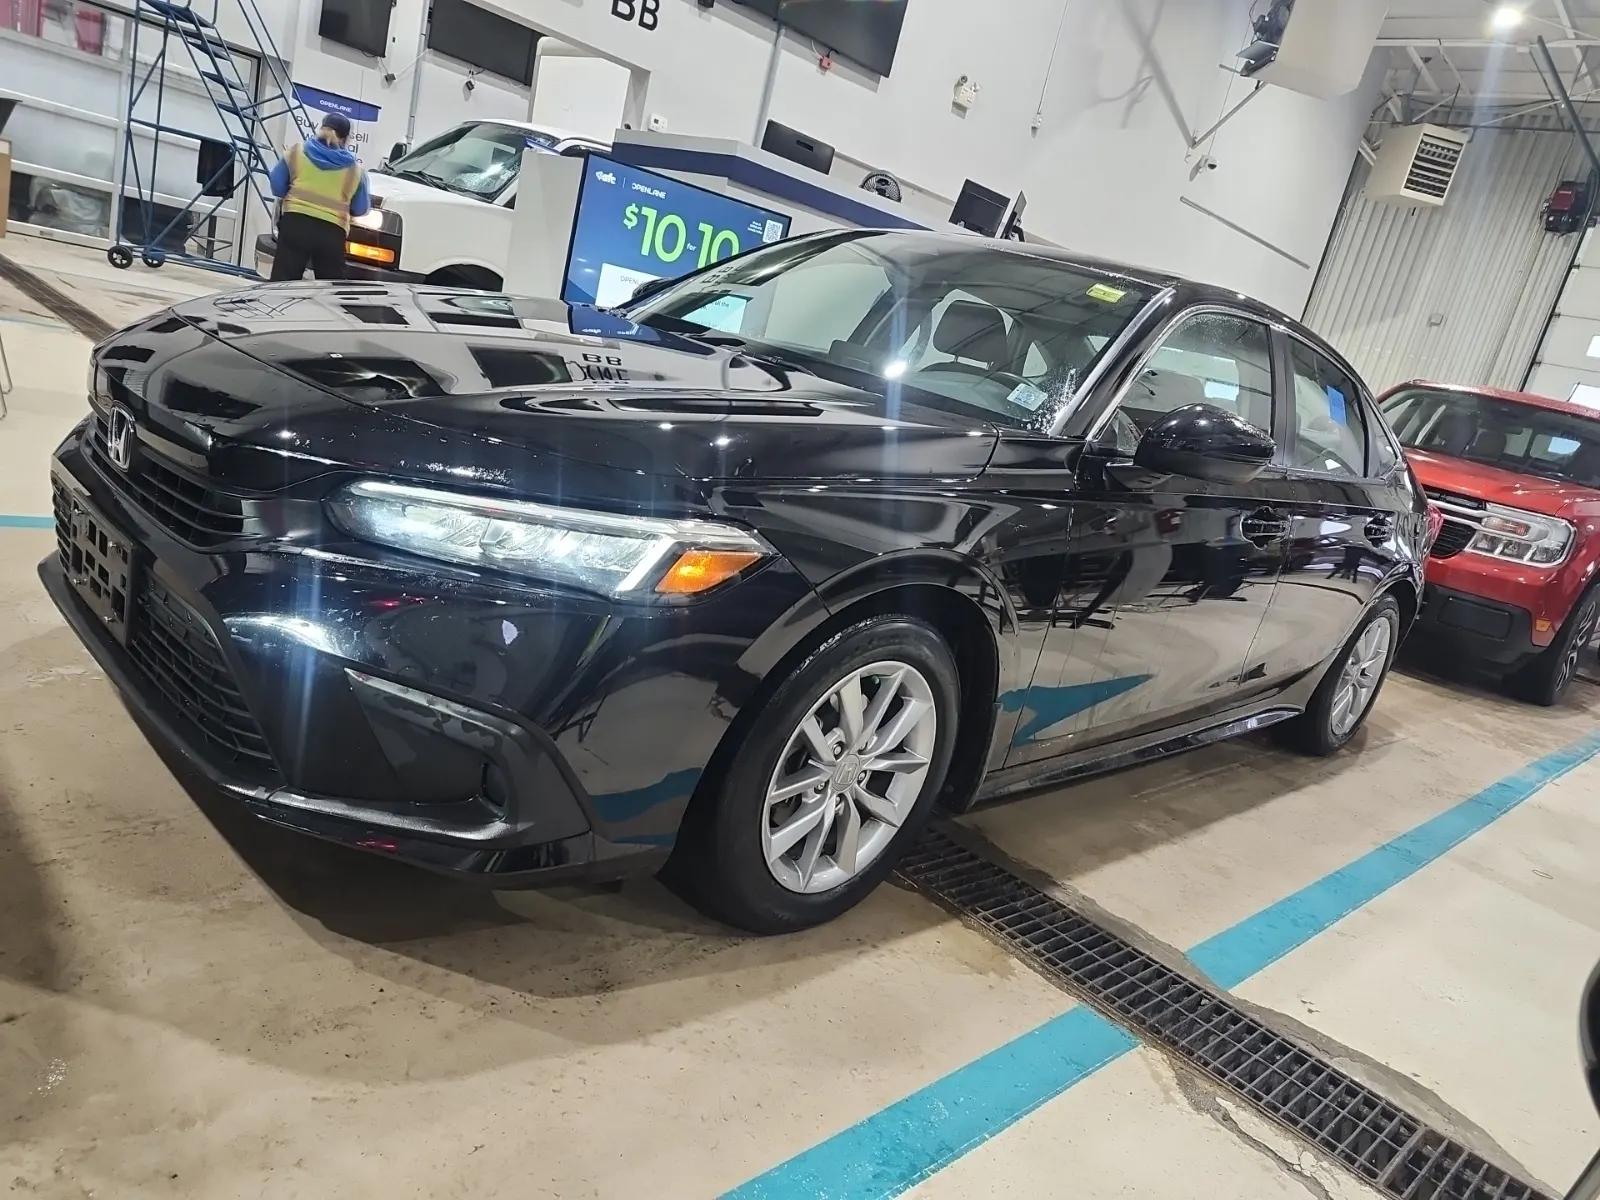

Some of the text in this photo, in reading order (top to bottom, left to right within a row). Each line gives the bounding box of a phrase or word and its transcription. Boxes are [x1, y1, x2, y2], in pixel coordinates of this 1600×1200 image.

[611, 0, 660, 31] BB
[320, 100, 352, 112] OPENLANE
[631, 182, 667, 199] OPENLANE
[623, 203, 740, 269] $10 for 10
